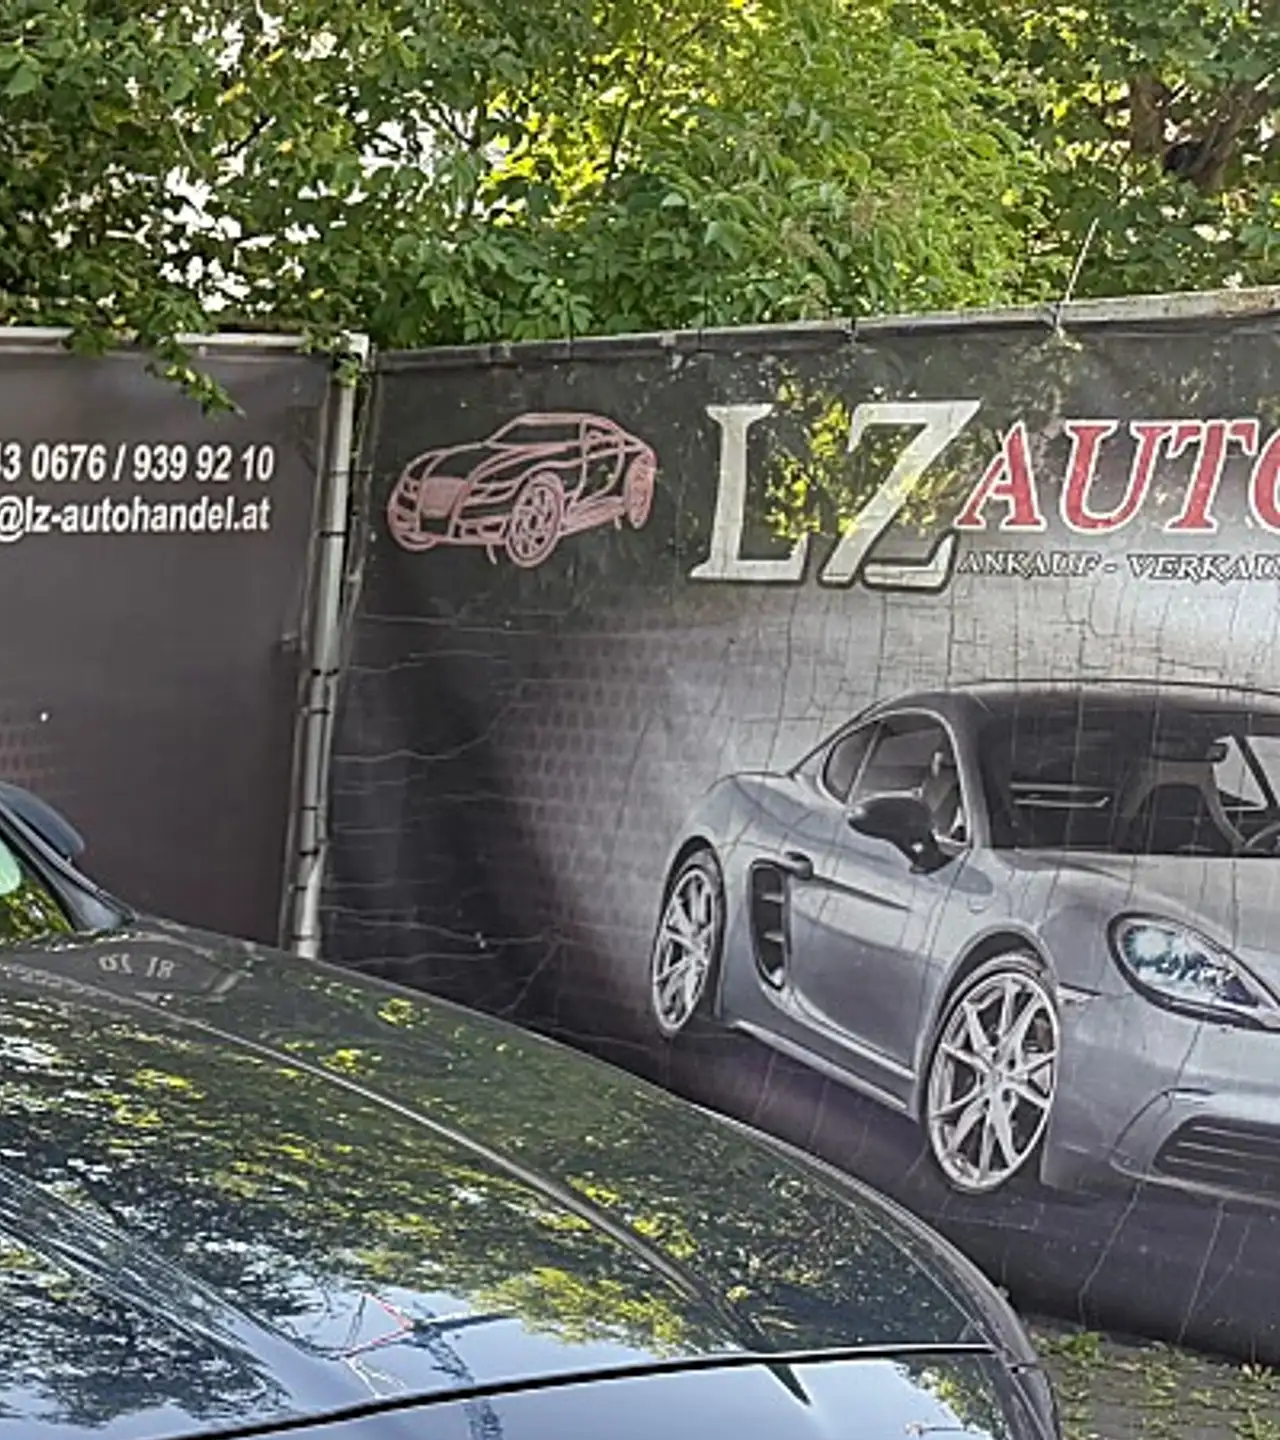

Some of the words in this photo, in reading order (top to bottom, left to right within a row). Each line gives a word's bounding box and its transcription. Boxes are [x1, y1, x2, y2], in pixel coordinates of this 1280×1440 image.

[31, 443, 107, 482] 0676
[112, 443, 127, 482] /
[133, 444, 188, 483] 939
[196, 445, 233, 482] 92
[242, 445, 274, 482] 10
[690, 398, 983, 592] LZ
[955, 551, 1102, 579] ANKAUF
